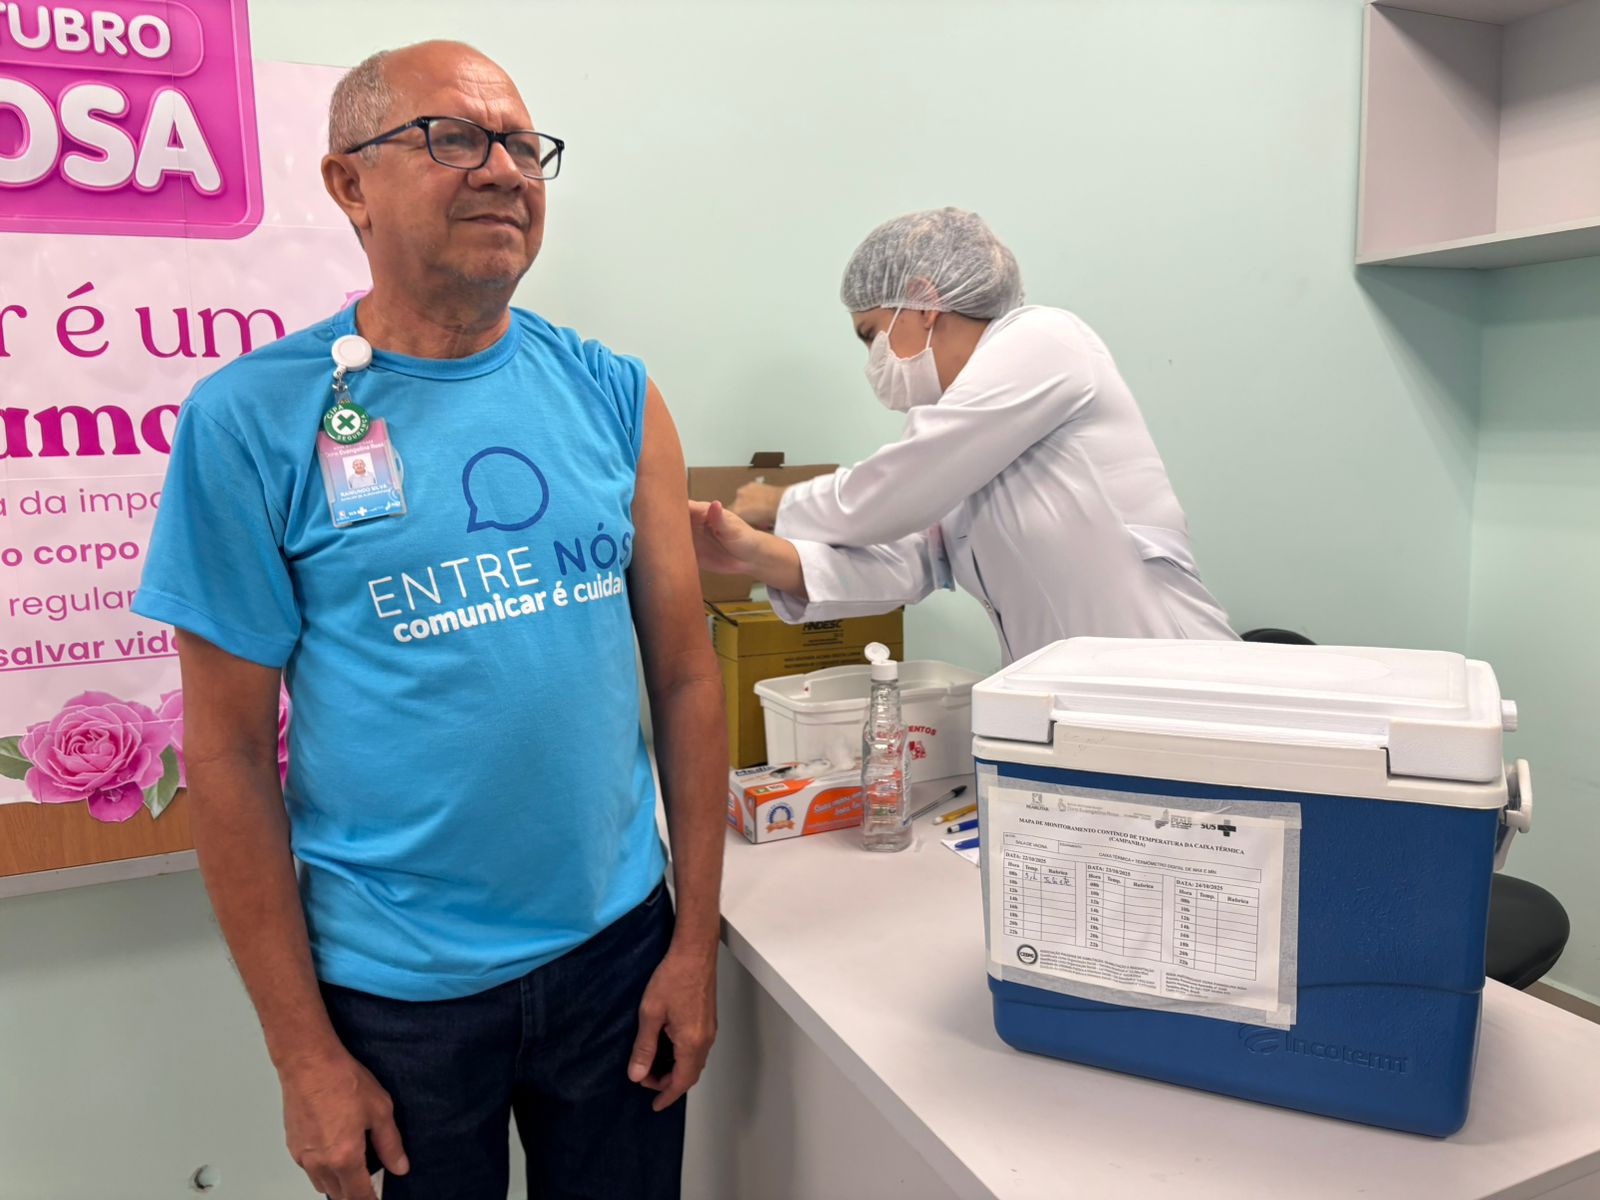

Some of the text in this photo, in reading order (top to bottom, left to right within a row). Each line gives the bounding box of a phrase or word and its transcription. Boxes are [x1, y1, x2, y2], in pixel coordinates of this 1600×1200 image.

[0, 1, 171, 58] UBRO
[56, 281, 109, 358] é
[135, 307, 286, 358] um
[326, 404, 344, 419] CIPA
[20, 490, 67, 516] da
[1, 541, 140, 569] o corpo
[368, 523, 631, 618] ENTRE NÓS
[393, 589, 546, 643] comunicar
[552, 581, 568, 607] é
[1044, 821, 1096, 834] MONITORAMENTO
[1138, 834, 1183, 847] TEMPERATURA
[1194, 842, 1214, 851] CAIXA
[1200, 823, 1216, 831] SUS
[1109, 837, 1146, 847] (CAMPANHA)
